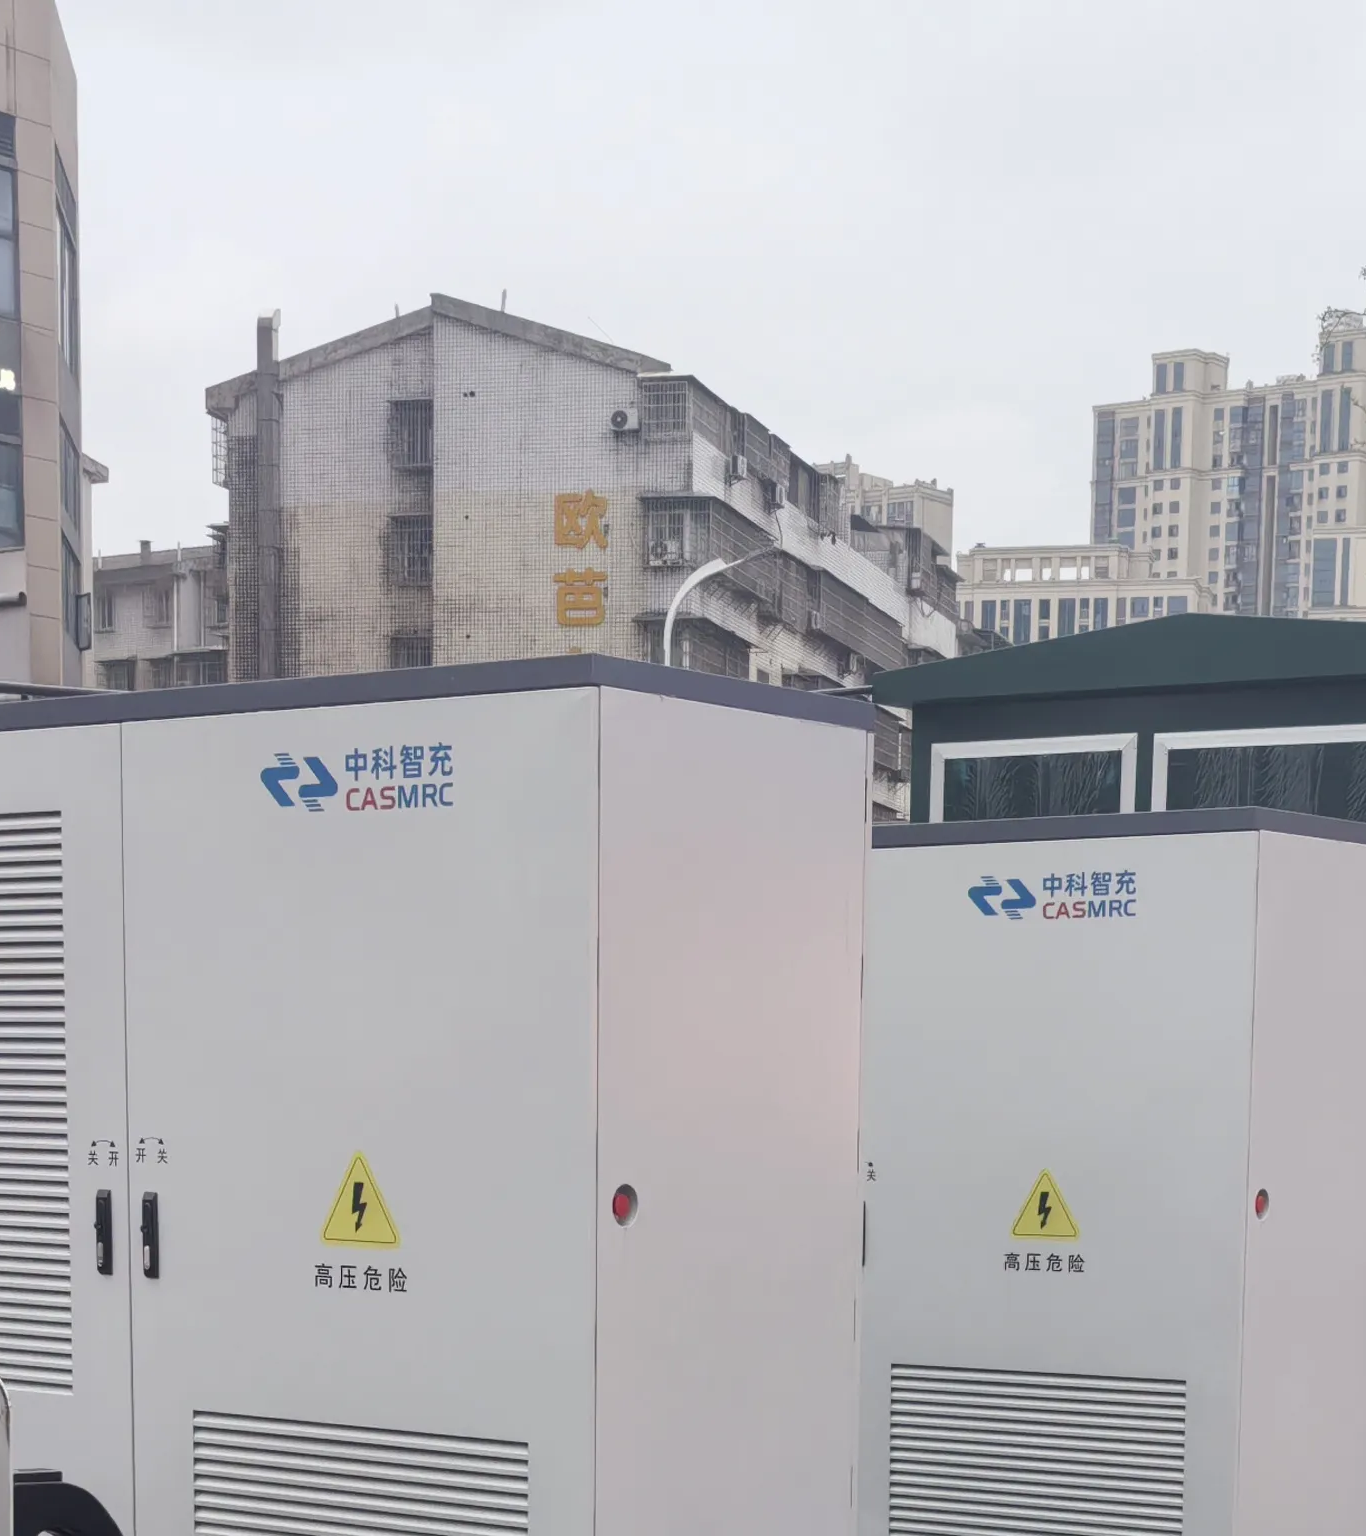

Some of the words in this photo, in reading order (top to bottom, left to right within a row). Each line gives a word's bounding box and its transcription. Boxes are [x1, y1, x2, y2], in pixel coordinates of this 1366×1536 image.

[553, 488, 609, 654] 欧芭
[345, 742, 454, 781] 中科智充
[345, 782, 454, 811] CASMRC
[1042, 869, 1137, 898] 中科智充
[1042, 898, 1137, 920] CASMRC
[87, 1150, 99, 1165] 关
[108, 1151, 119, 1166] 开
[135, 1148, 147, 1163] 开
[157, 1149, 168, 1164] 关
[866, 1169, 877, 1182] 关
[1003, 1252, 1086, 1273] 高压危险
[313, 1263, 408, 1293] 高压危险
